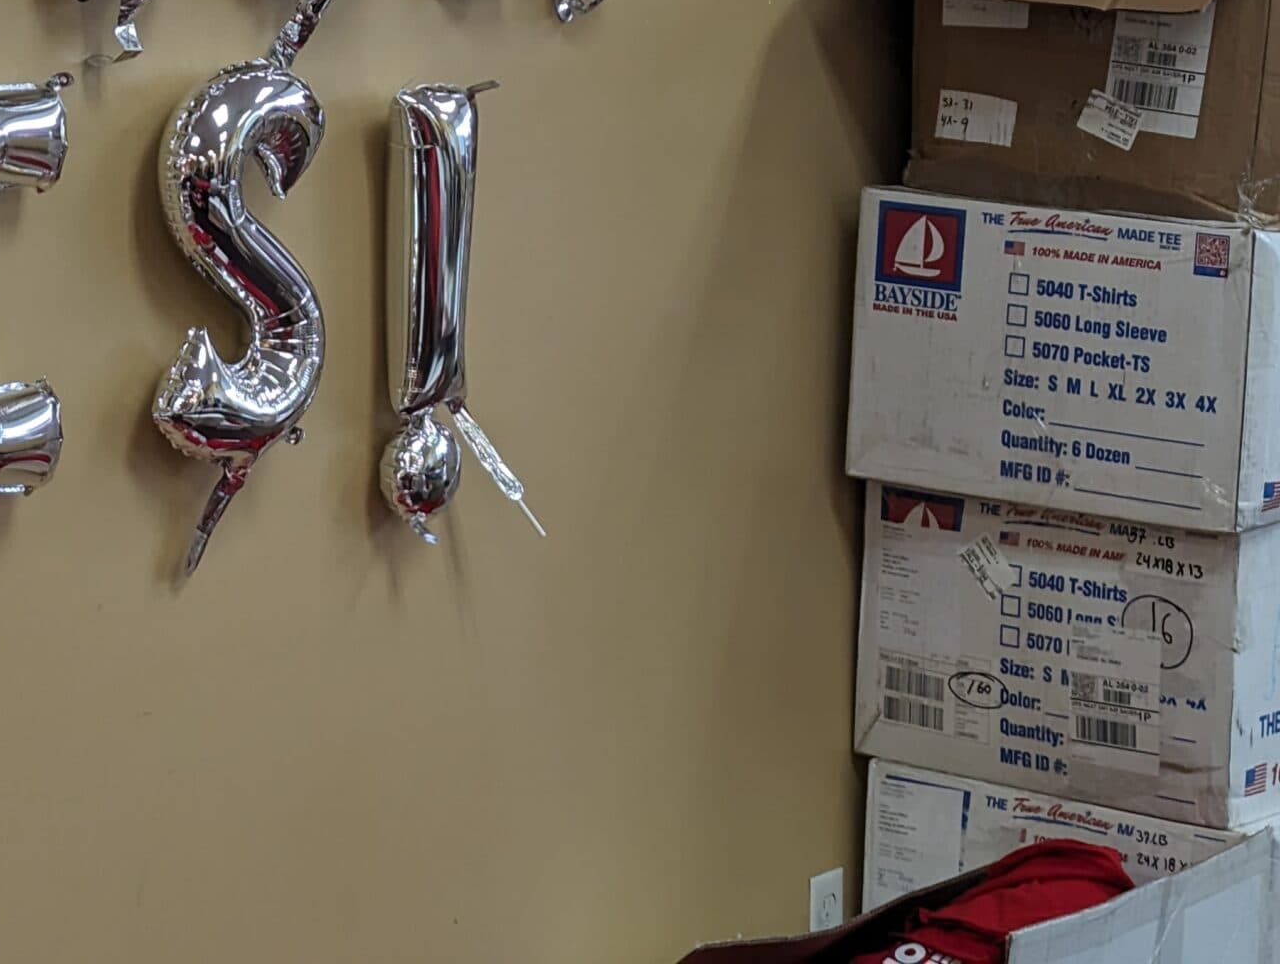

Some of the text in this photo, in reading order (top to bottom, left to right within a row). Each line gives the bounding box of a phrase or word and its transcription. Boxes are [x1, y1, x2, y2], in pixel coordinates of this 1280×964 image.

[982, 211, 1182, 246] THE True American MADE TEE
[1032, 246, 1162, 271] 100% MADE IN AMERICA
[874, 283, 958, 311] BAYSIDE
[1036, 279, 1138, 308] 5040 T-Shirts
[873, 302, 957, 321] MADE IN THE USA
[1034, 310, 1168, 343] 5060 Long Sleeve
[1032, 341, 1151, 373] 5070 Pocket-TS
[1004, 369, 1218, 414] Size: S M L XL 2X 3X 4X
[1002, 399, 1045, 421] Color:
[1001, 429, 1131, 465] Quantity: 6 Dozen
[1000, 460, 1033, 482] MFG
[1036, 465, 1052, 484] ID
[979, 502, 1001, 517] THE
[1056, 543, 1087, 557] MADE
[1089, 548, 1101, 559] IN
[1029, 571, 1128, 603] 5040 T-Shirts
[1027, 602, 1063, 624] 5060
[1026, 632, 1063, 654] 5070
[1000, 657, 1035, 680] Size:
[1043, 665, 1052, 683] S
[1000, 717, 1065, 748] Quantity:
[1000, 747, 1032, 769] MFG
[1035, 753, 1050, 773] ID
[985, 795, 1008, 811] THE
[1047, 803, 1114, 831] American
